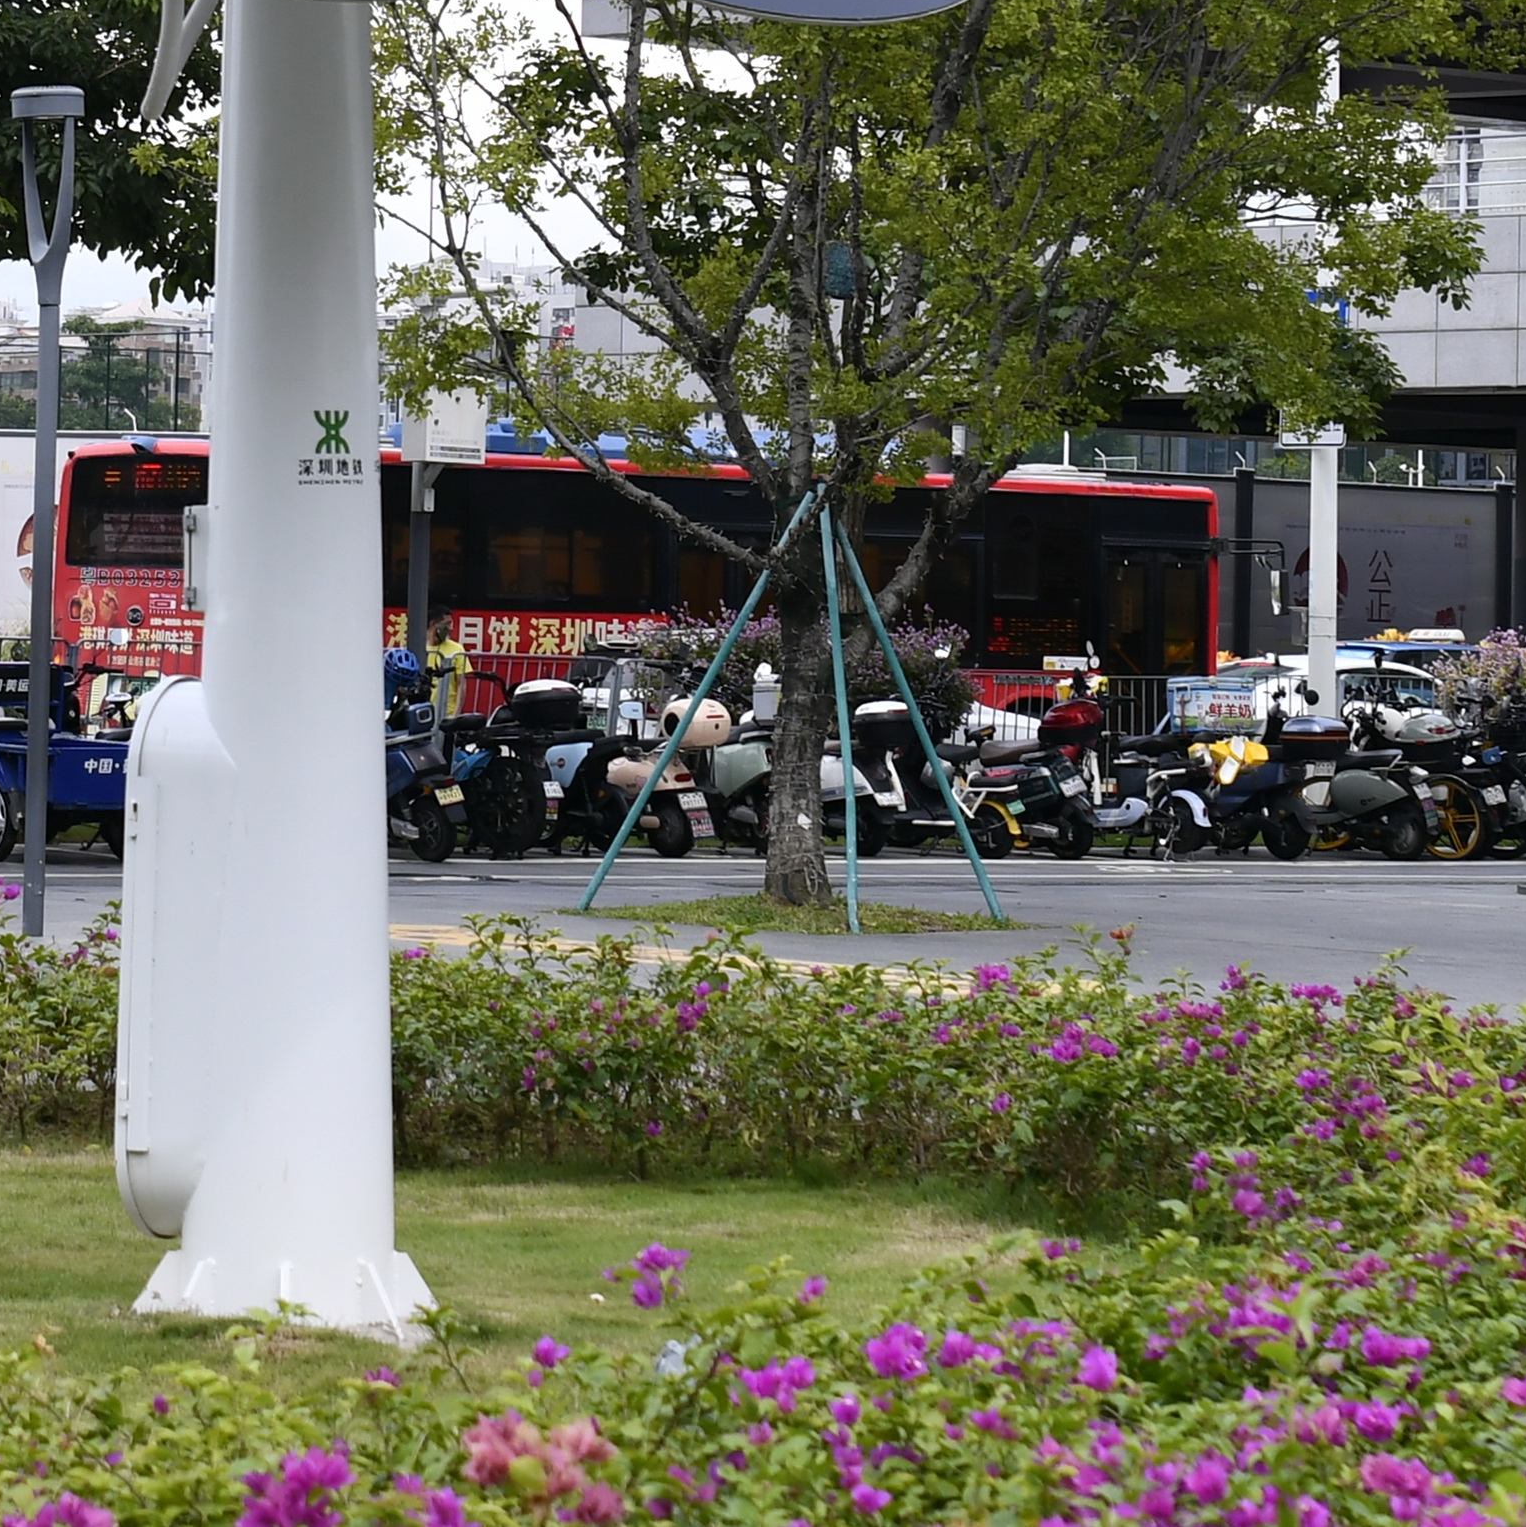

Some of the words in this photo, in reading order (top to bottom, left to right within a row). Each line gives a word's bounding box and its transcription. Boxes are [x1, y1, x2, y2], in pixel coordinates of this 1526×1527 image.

[298, 458, 364, 476] 深圳地铁
[1368, 550, 1393, 623] 公正
[1209, 702, 1252, 719] 鲜羊奶
